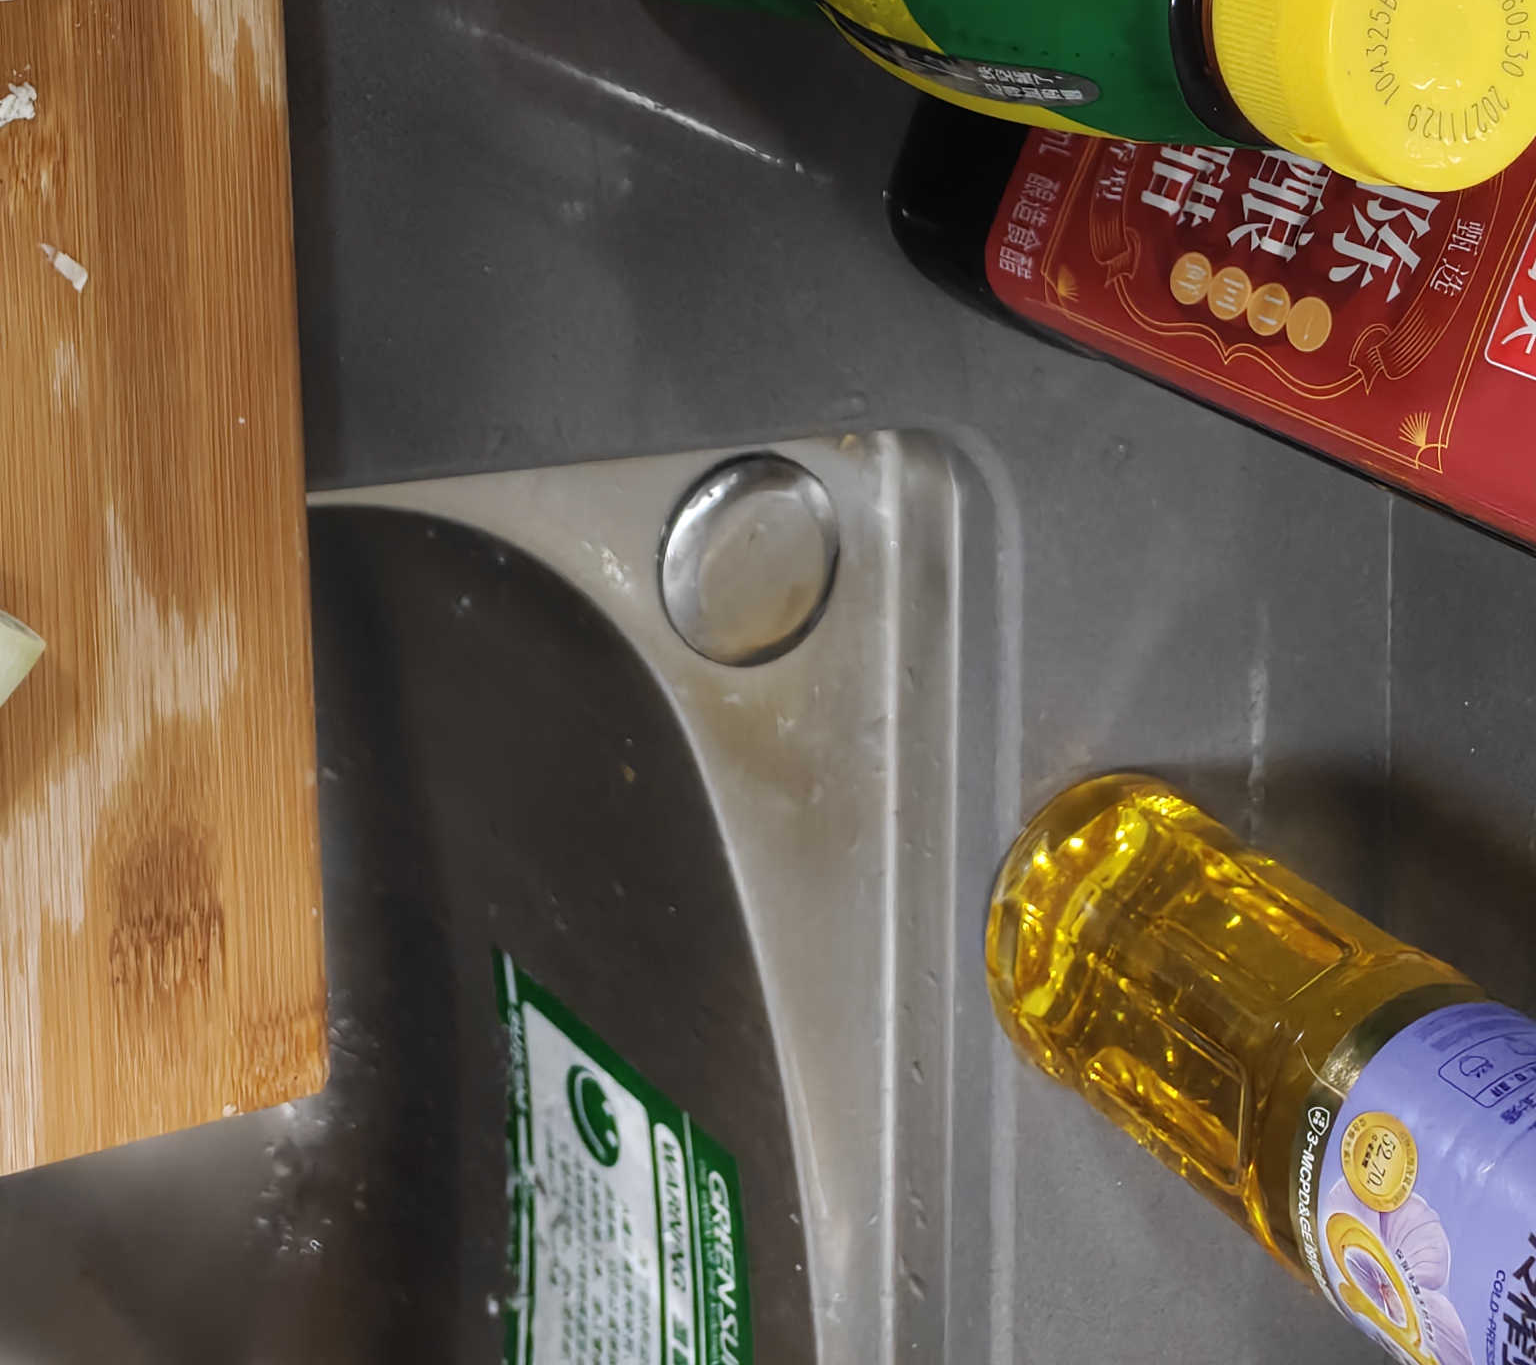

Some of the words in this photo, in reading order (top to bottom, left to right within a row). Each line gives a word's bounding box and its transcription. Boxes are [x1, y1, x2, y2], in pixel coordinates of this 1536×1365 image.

[1407, 85, 1510, 142] 20271129
[999, 172, 1061, 280] 酿造食醋
[1430, 218, 1485, 297] 甄选
